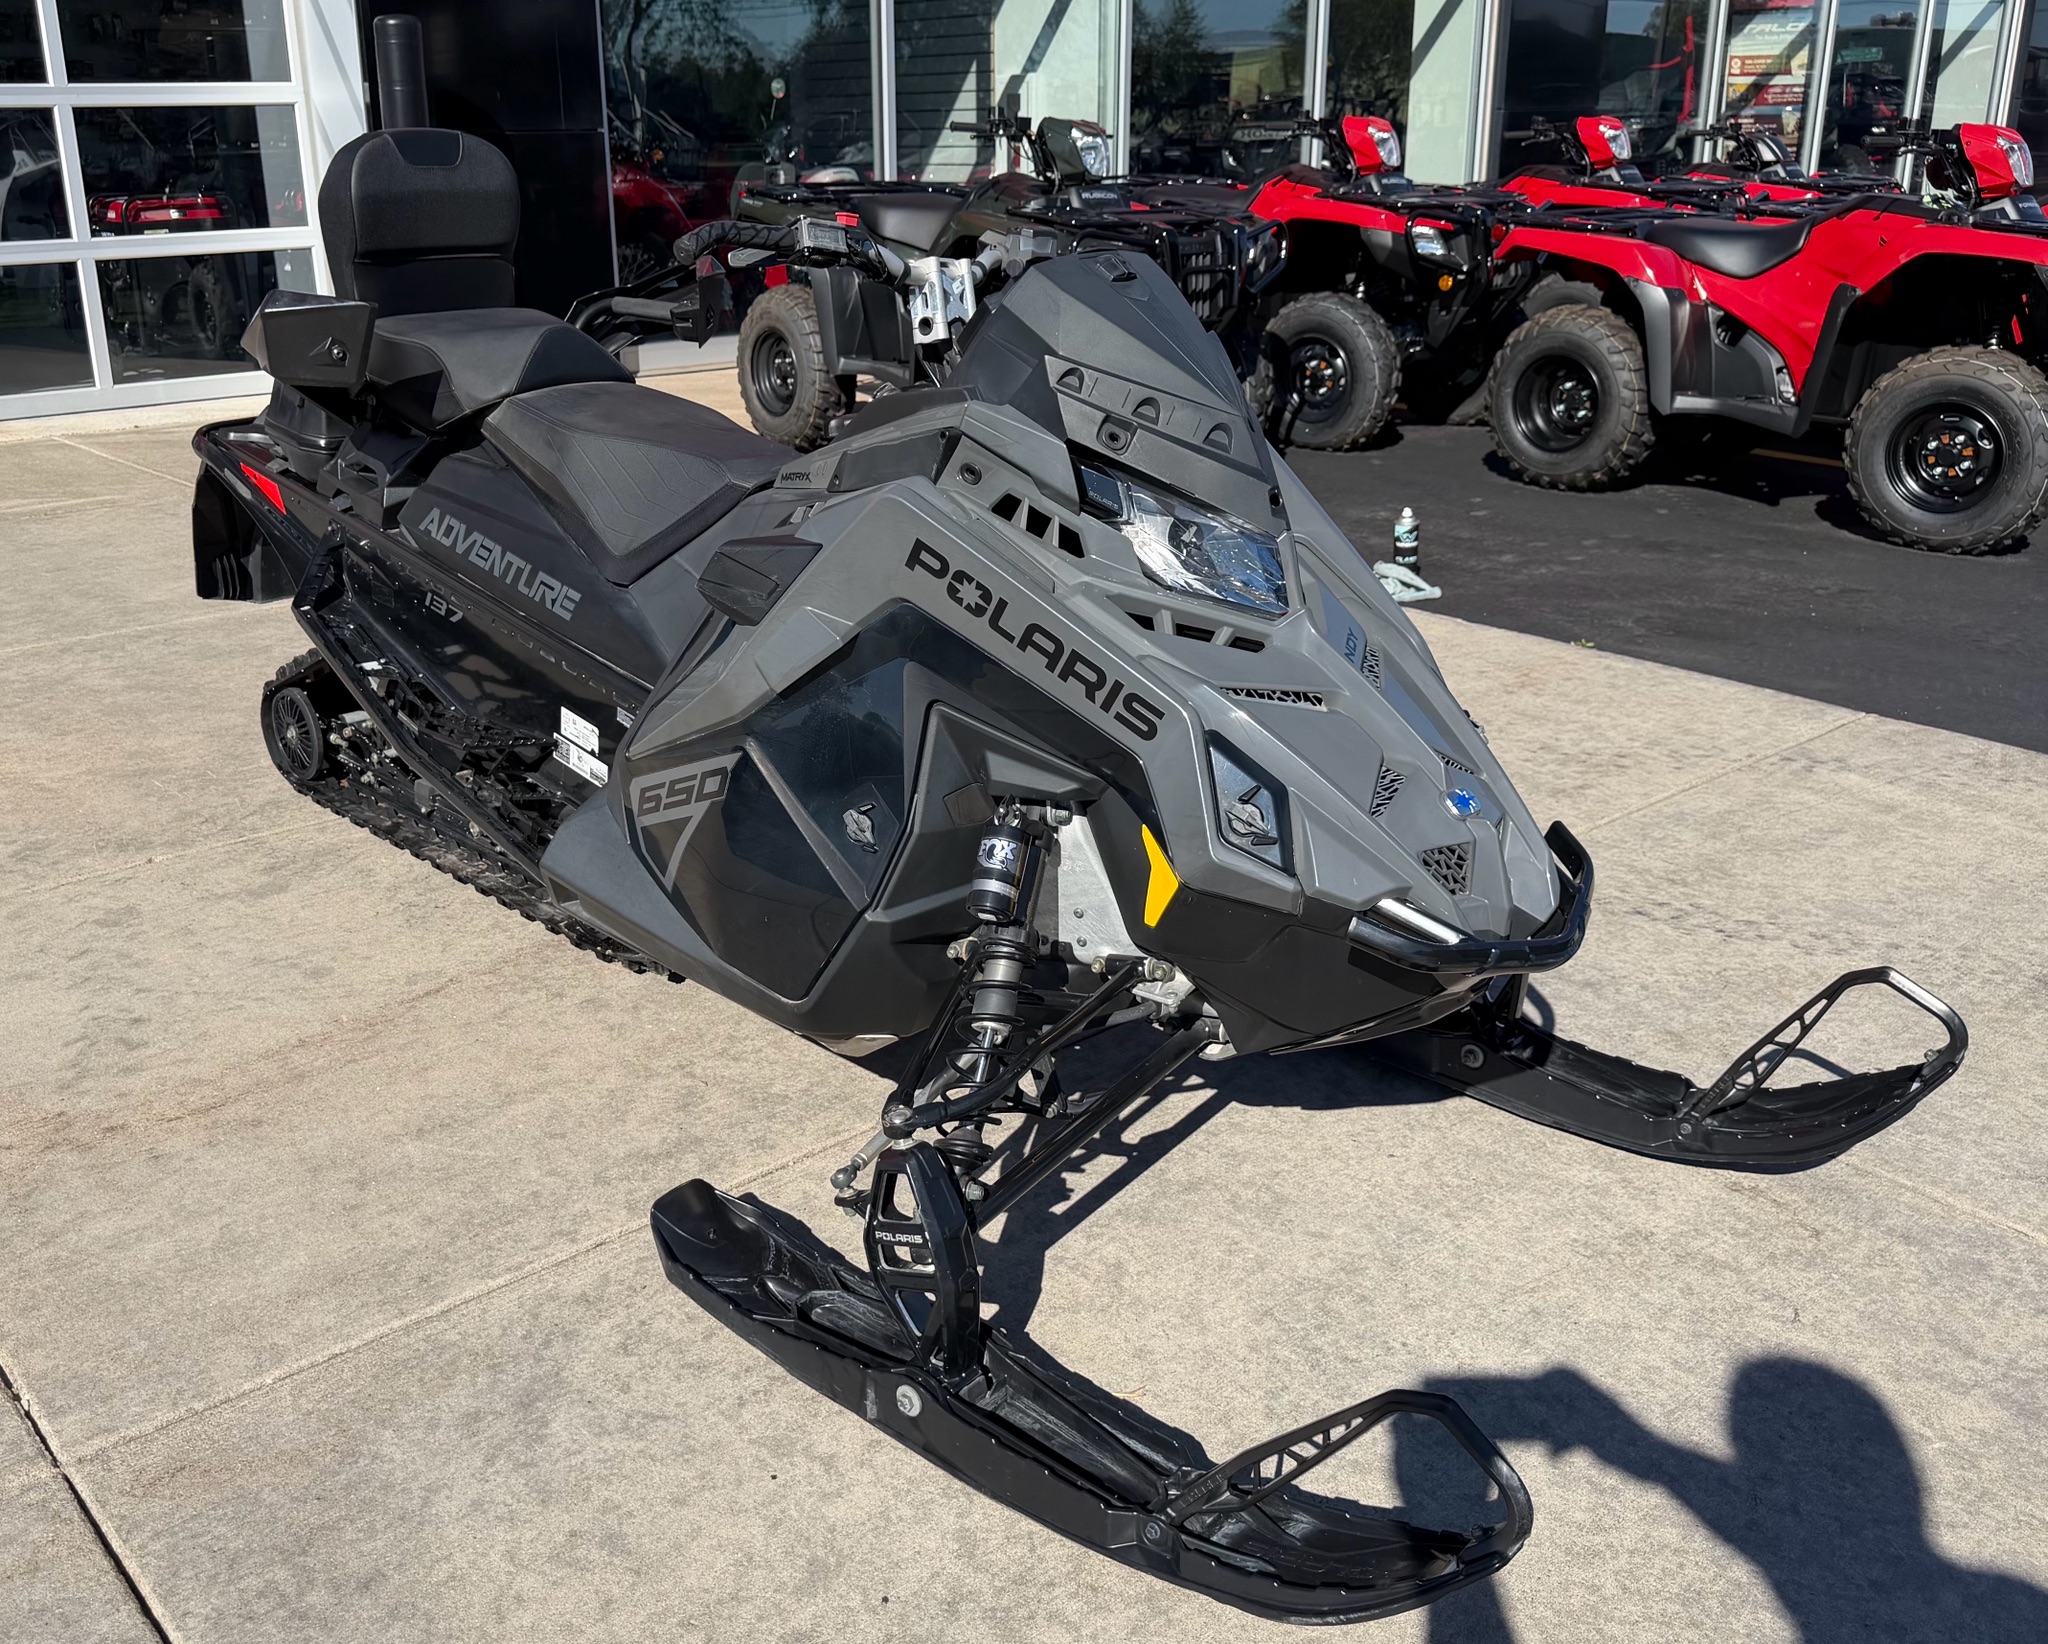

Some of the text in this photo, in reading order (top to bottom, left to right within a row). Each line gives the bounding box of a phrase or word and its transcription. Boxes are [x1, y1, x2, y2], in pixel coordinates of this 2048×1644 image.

[1743, 22, 1806, 34] TALO
[780, 472, 812, 484] MATRYX
[418, 507, 582, 621] ADVENTURE
[424, 592, 464, 623] 137
[904, 537, 1166, 742] POLARIS
[1343, 626, 1359, 664] NDY
[637, 766, 729, 818] 650
[978, 838, 1017, 868] FOX
[874, 1230, 924, 1244] POLARIS
